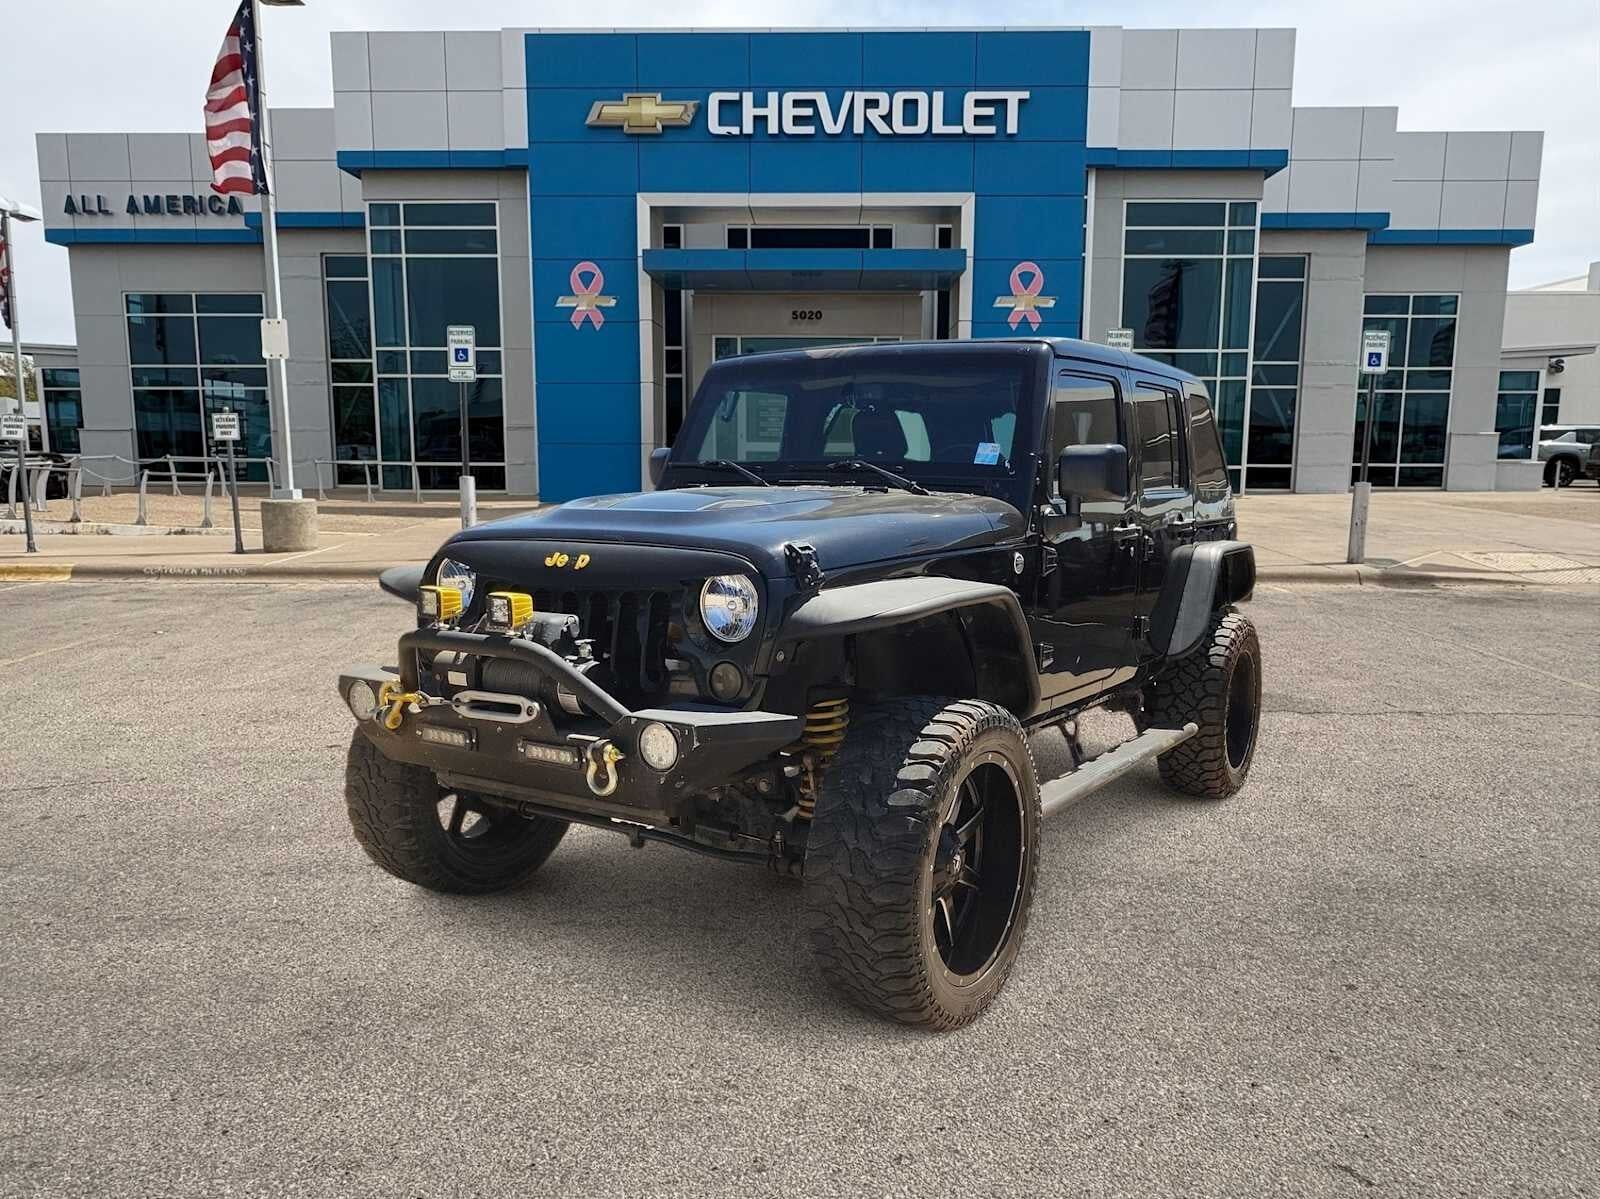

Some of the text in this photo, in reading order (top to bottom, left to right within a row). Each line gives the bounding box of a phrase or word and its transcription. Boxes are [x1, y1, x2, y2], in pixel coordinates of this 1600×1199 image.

[707, 90, 1031, 136] CHEVROLET
[63, 194, 244, 217] ALL AMERICA
[791, 310, 823, 320] 5020
